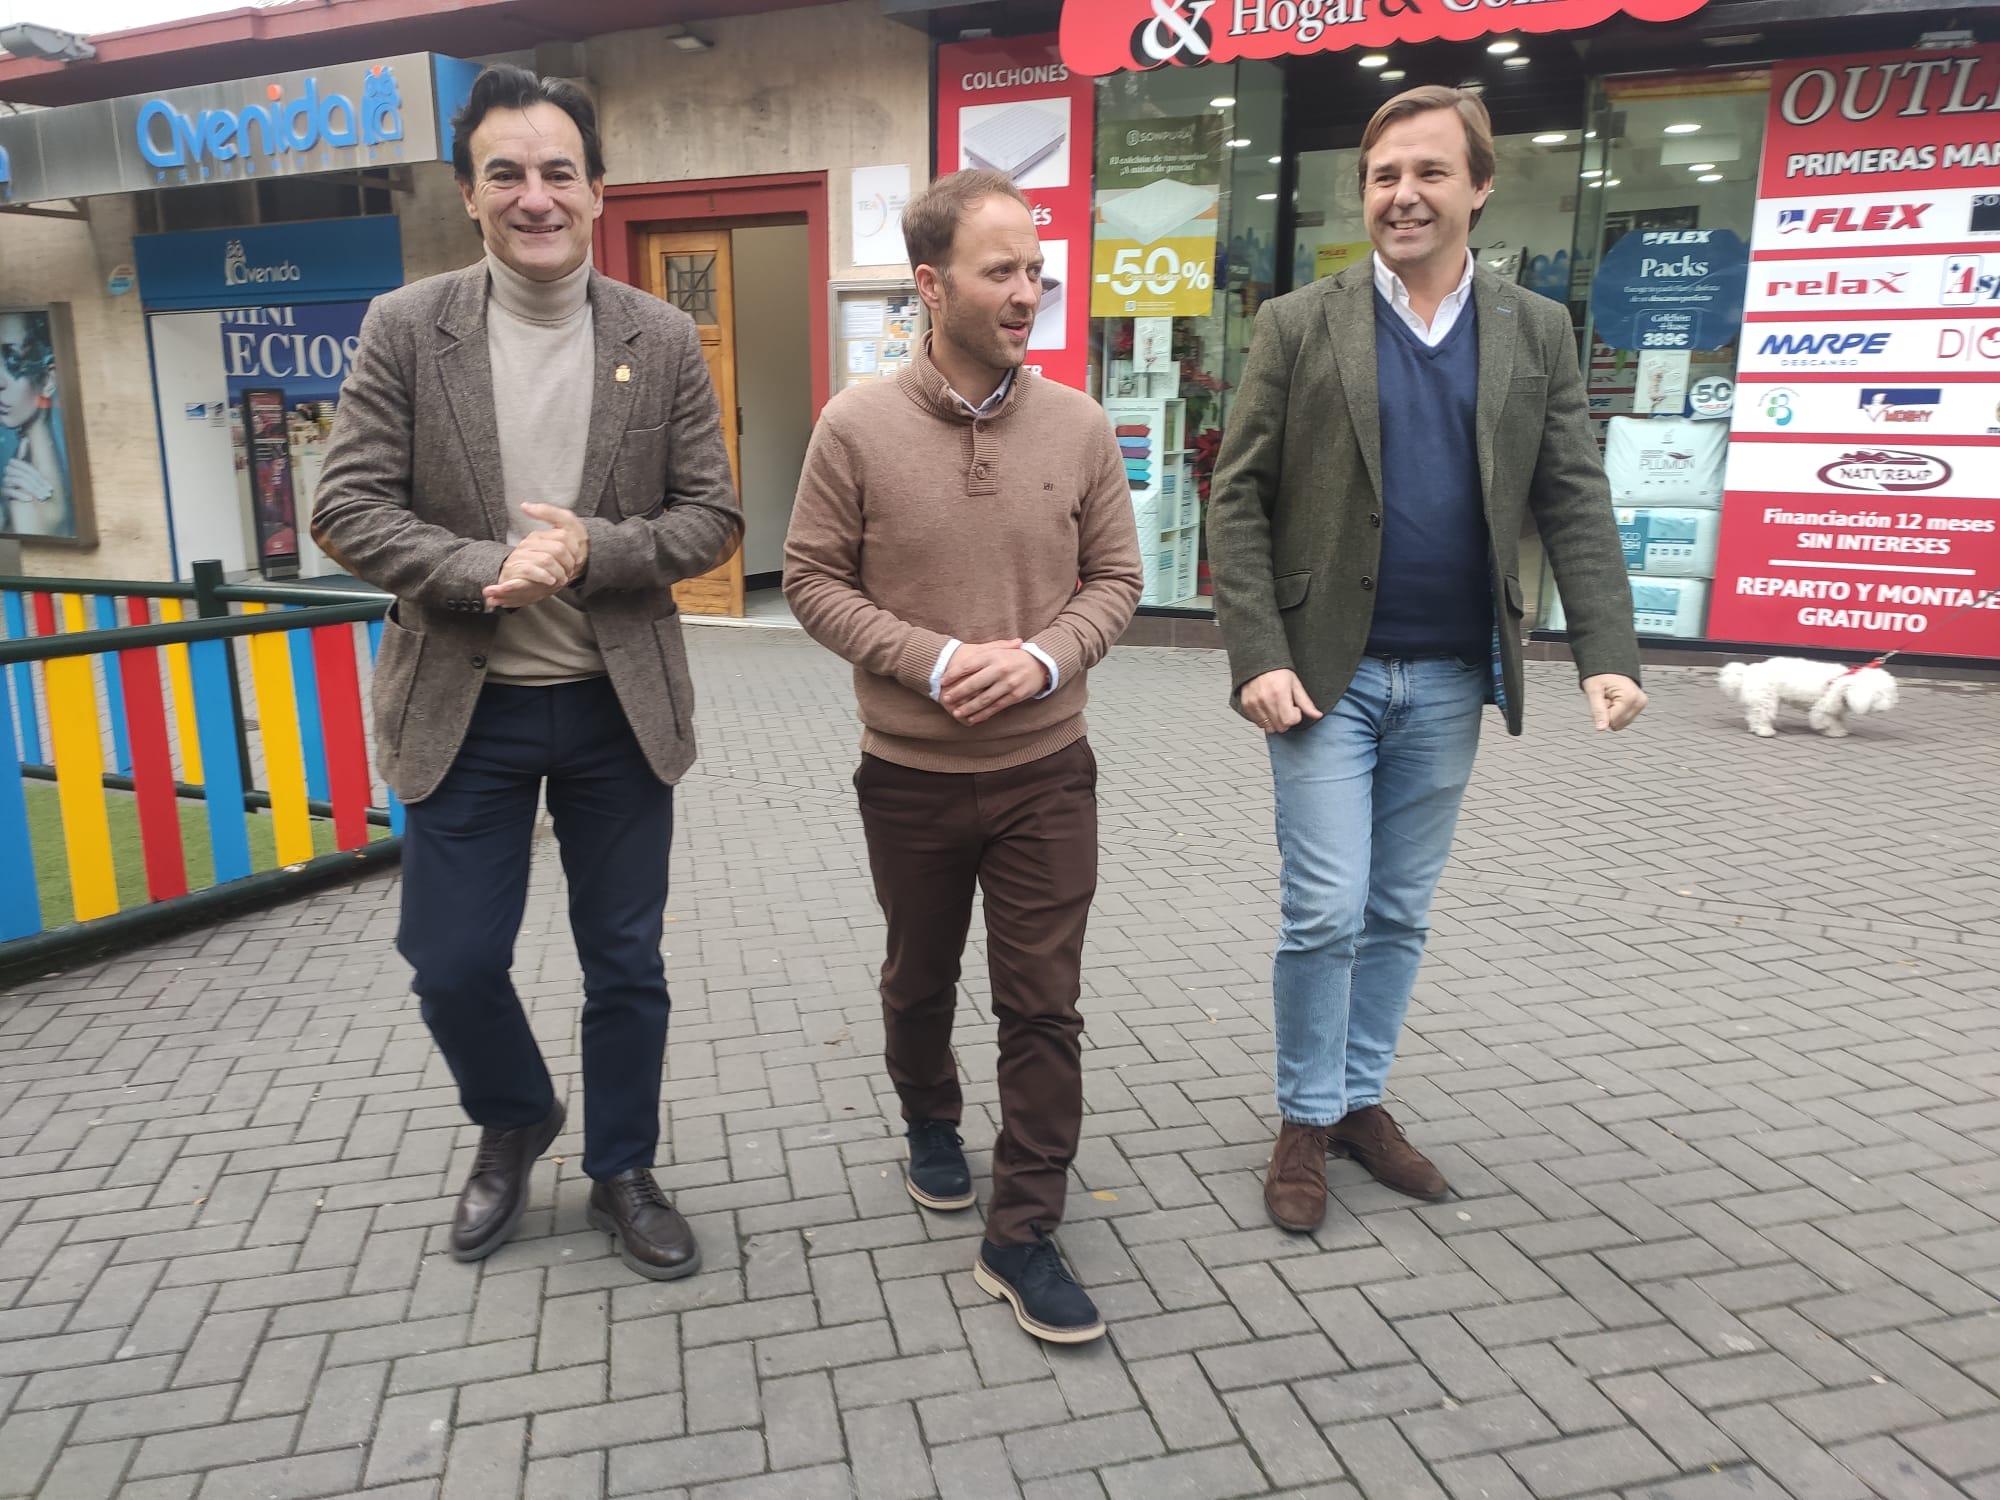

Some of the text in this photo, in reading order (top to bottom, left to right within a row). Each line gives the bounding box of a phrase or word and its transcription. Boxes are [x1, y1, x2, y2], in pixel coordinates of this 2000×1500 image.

[1228, 0, 1367, 43] Hogar
[961, 63, 1069, 91] COLCHONES
[1780, 57, 2000, 126] OUTL
[1785, 145, 1938, 178] PRIMERAS
[1032, 202, 1052, 226] ÉS
[1806, 203, 1933, 234] FLEX
[1656, 230, 1714, 245] FLEX
[1095, 246, 1211, 296] -50%
[1639, 255, 1710, 278] Packs
[1766, 271, 1910, 297] relax
[1642, 332, 1690, 346] 389€
[1756, 332, 1893, 355] MARPE
[1763, 508, 1996, 533] Financiación 12 meses
[1796, 532, 1952, 555] SIN INTERESES
[1735, 576, 2000, 610] REPARTO Y MONTAJE
[1797, 607, 1928, 633] GRATUITO
